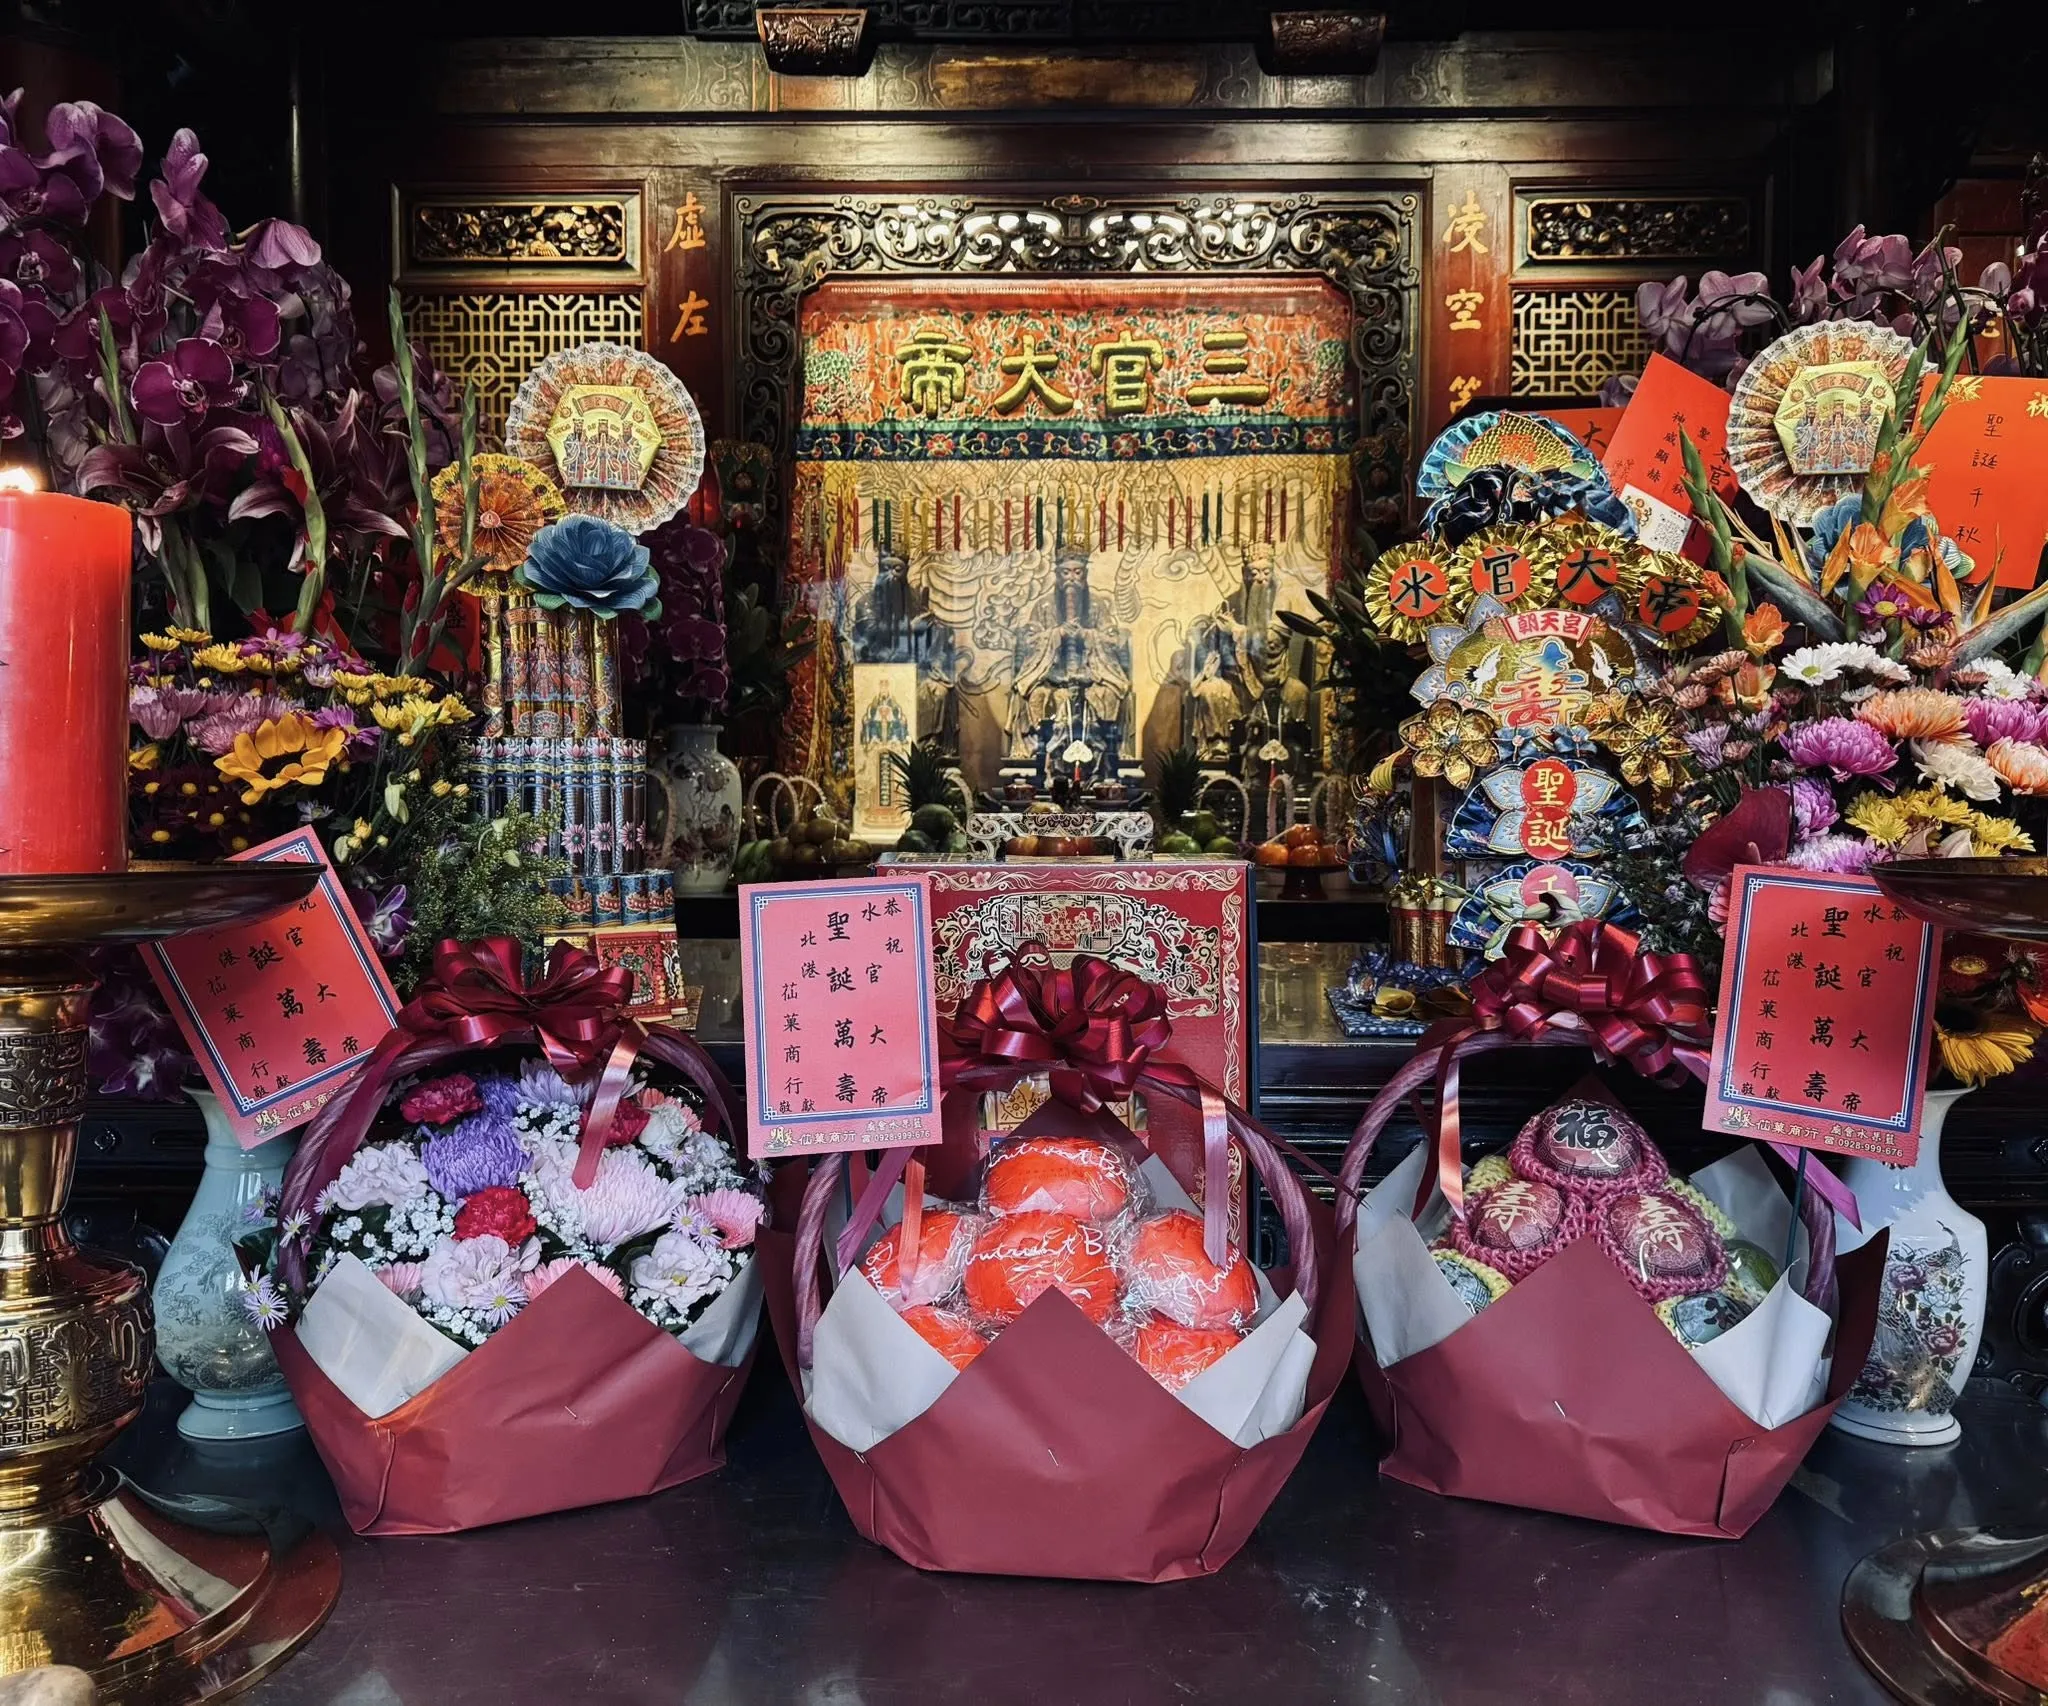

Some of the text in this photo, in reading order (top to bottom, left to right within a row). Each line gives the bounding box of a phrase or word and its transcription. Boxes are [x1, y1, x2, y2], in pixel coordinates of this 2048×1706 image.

[1443, 190, 1488, 414] 凌空
[1954, 413, 2004, 544] 聖誕千秋
[1393, 547, 1693, 627] 水官大帝
[1518, 611, 1582, 635] 朝天宮
[800, 930, 821, 979] 北港
[884, 897, 904, 954] 恭祝
[1786, 922, 1809, 970] 北港
[247, 939, 328, 1067] 誕萬壽
[285, 926, 360, 1055] 官大帝
[826, 910, 858, 1104] 聖誕萬壽
[861, 902, 889, 1107] 水官大帝
[1803, 907, 1849, 1102] 聖誕萬壽
[1841, 903, 1885, 1113] 水官大帝
[1553, 1108, 1620, 1151] 福
[1838, 1138, 1904, 1158] 0928-999-676
[1481, 1179, 1537, 1232] 壽
[1635, 1194, 1692, 1253] 壽
